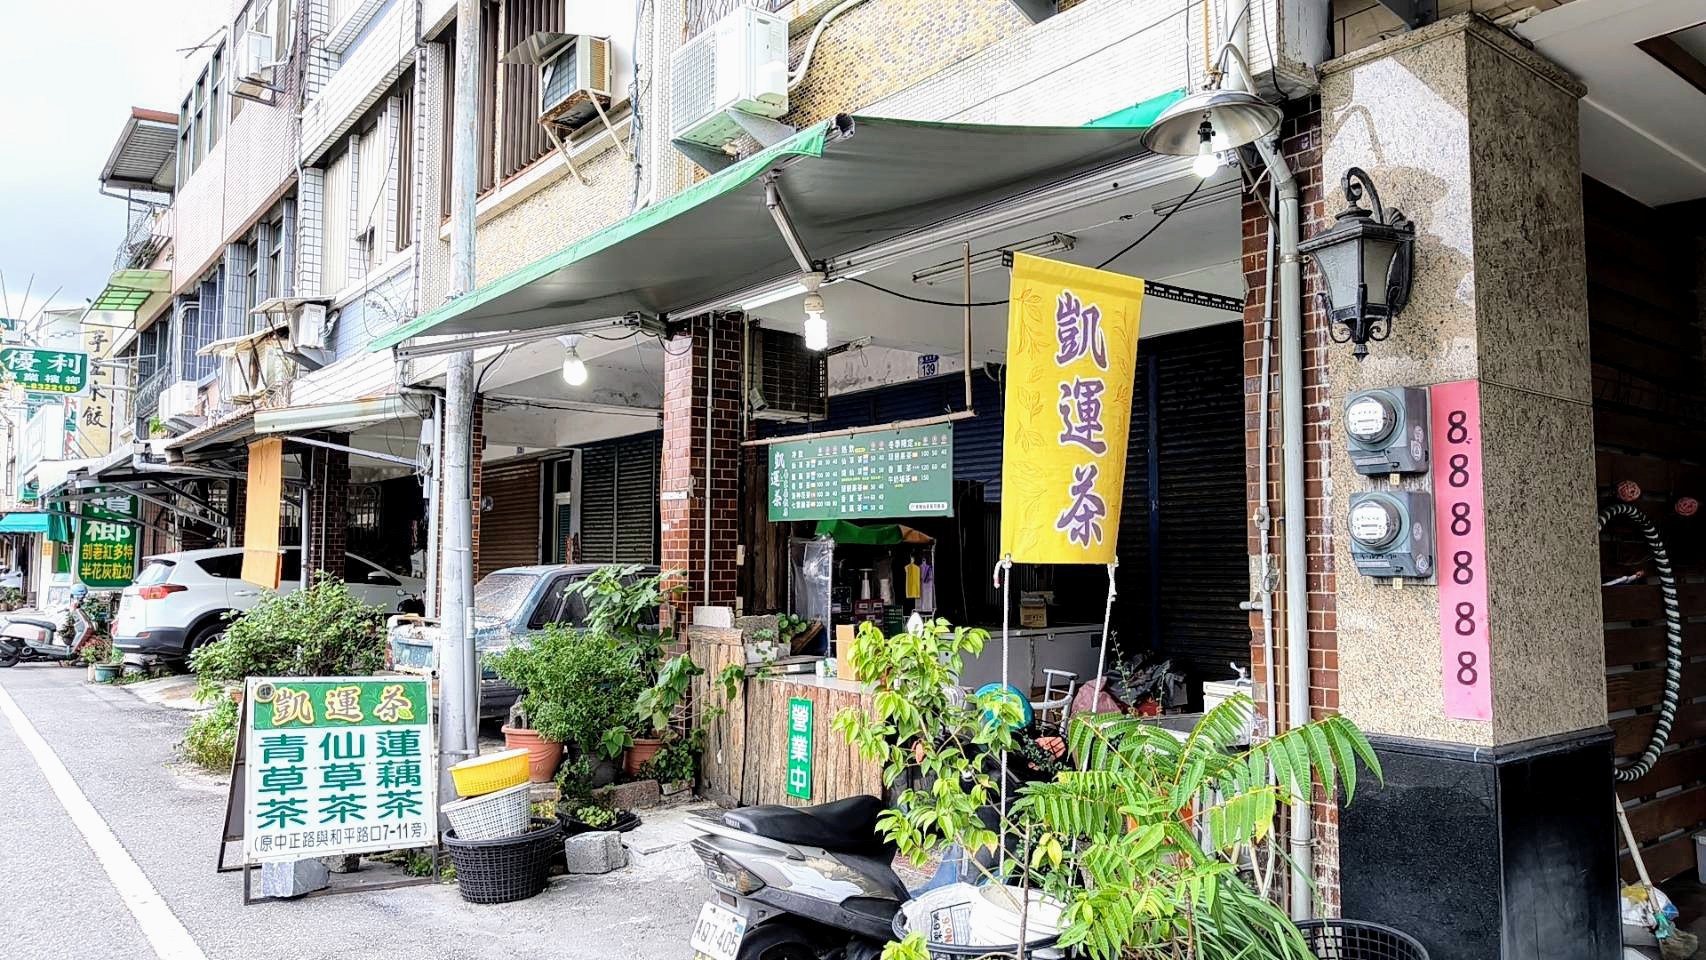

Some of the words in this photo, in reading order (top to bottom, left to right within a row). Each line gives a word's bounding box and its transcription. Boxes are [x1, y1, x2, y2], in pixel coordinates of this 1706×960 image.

[4, 350, 82, 375] 優利
[922, 363, 935, 376] 139
[1056, 291, 1109, 546] 凱運茶
[771, 451, 785, 507] 凱運茶
[272, 685, 411, 726] 凱運茶
[790, 704, 809, 793] 營業中
[257, 734, 308, 829] 青草茶
[318, 731, 367, 823] 仙草茶
[376, 729, 423, 818] 蓮藕茶
